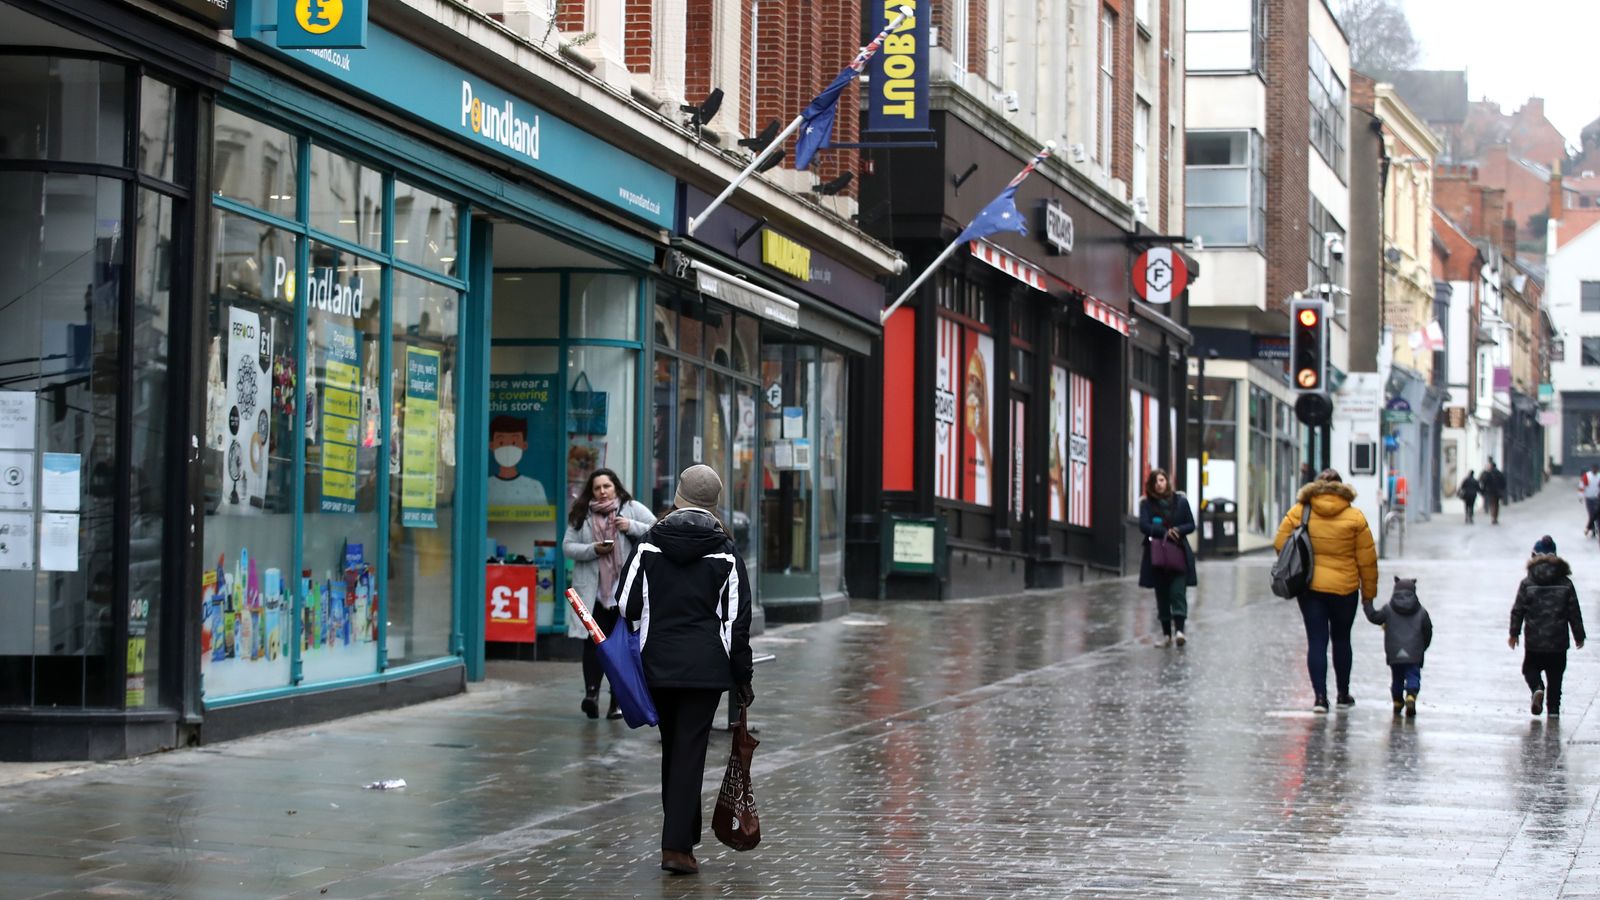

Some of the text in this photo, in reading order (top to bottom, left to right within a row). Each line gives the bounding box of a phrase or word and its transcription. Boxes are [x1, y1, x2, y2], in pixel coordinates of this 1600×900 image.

[1154, 268, 1164, 282] F
[511, 380, 538, 389] wear
[542, 380, 549, 389] a
[498, 390, 548, 402] covering
[511, 402, 544, 411] store.
[490, 585, 529, 620] £1
